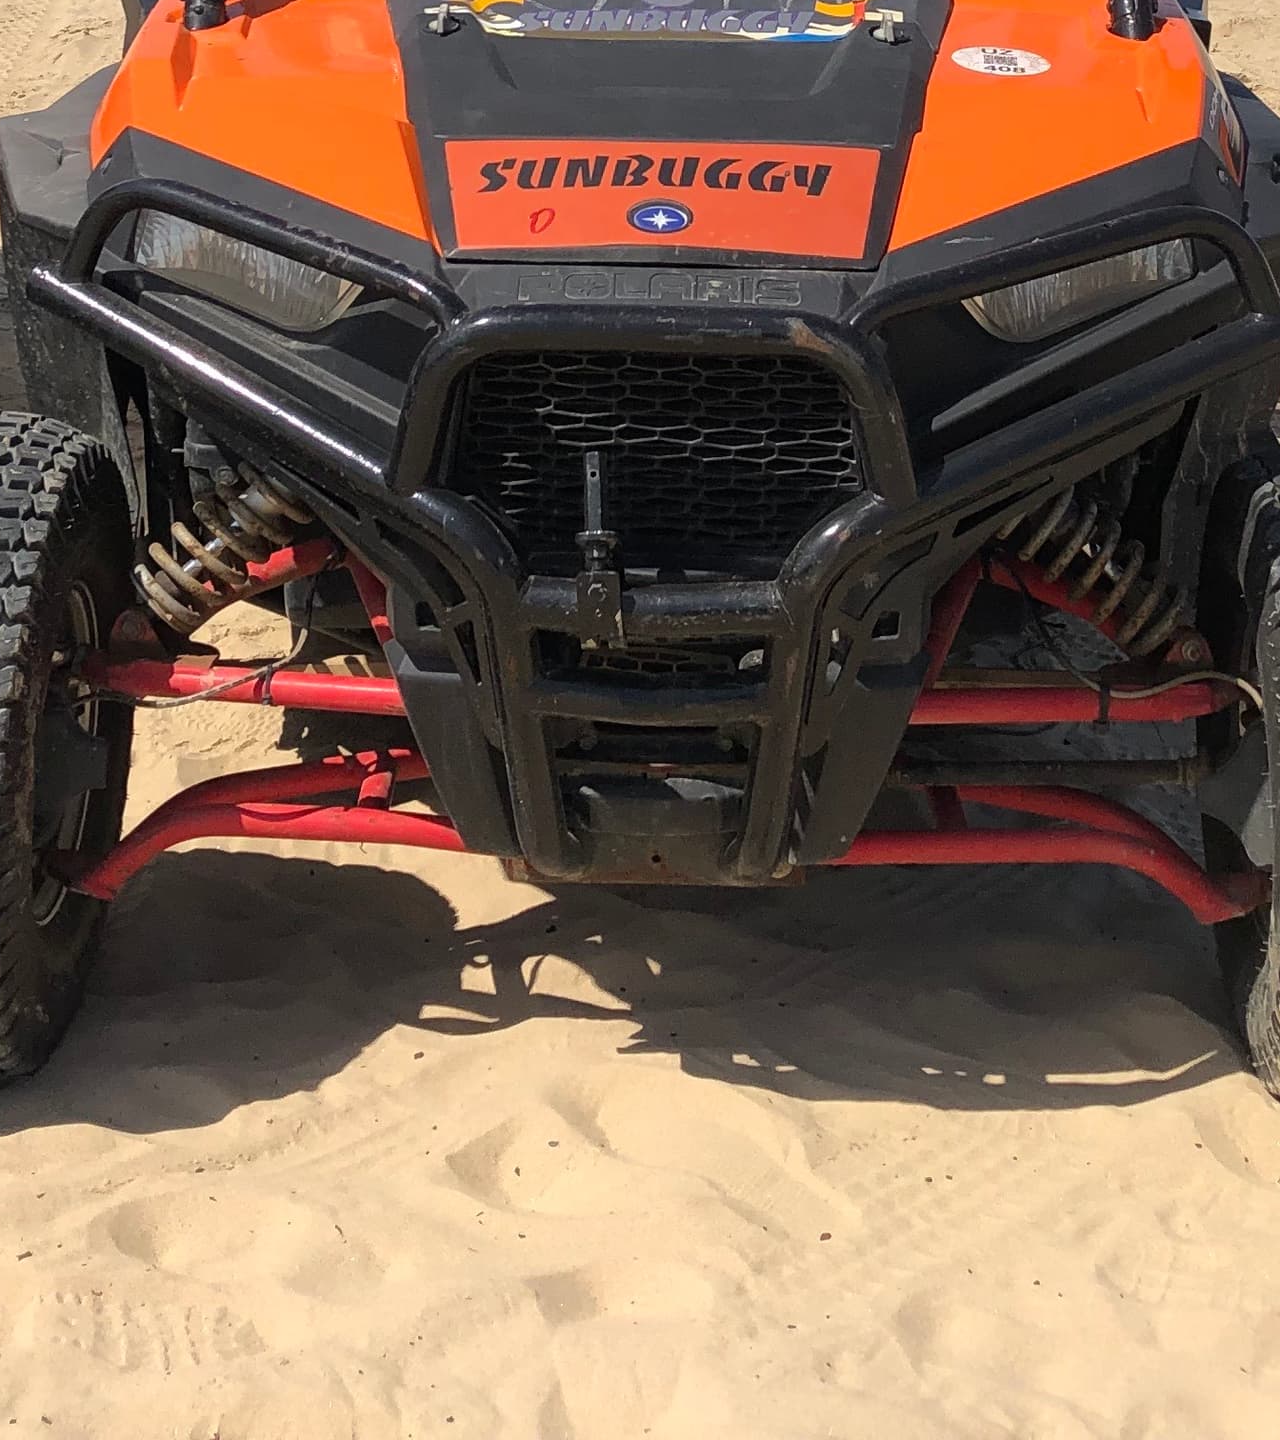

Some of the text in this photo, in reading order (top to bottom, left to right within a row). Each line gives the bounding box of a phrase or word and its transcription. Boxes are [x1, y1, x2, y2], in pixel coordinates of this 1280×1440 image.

[519, 9, 816, 34] SUNBUGGY
[477, 154, 833, 197] SUNBUGGY
[518, 271, 801, 306] POLARIS
